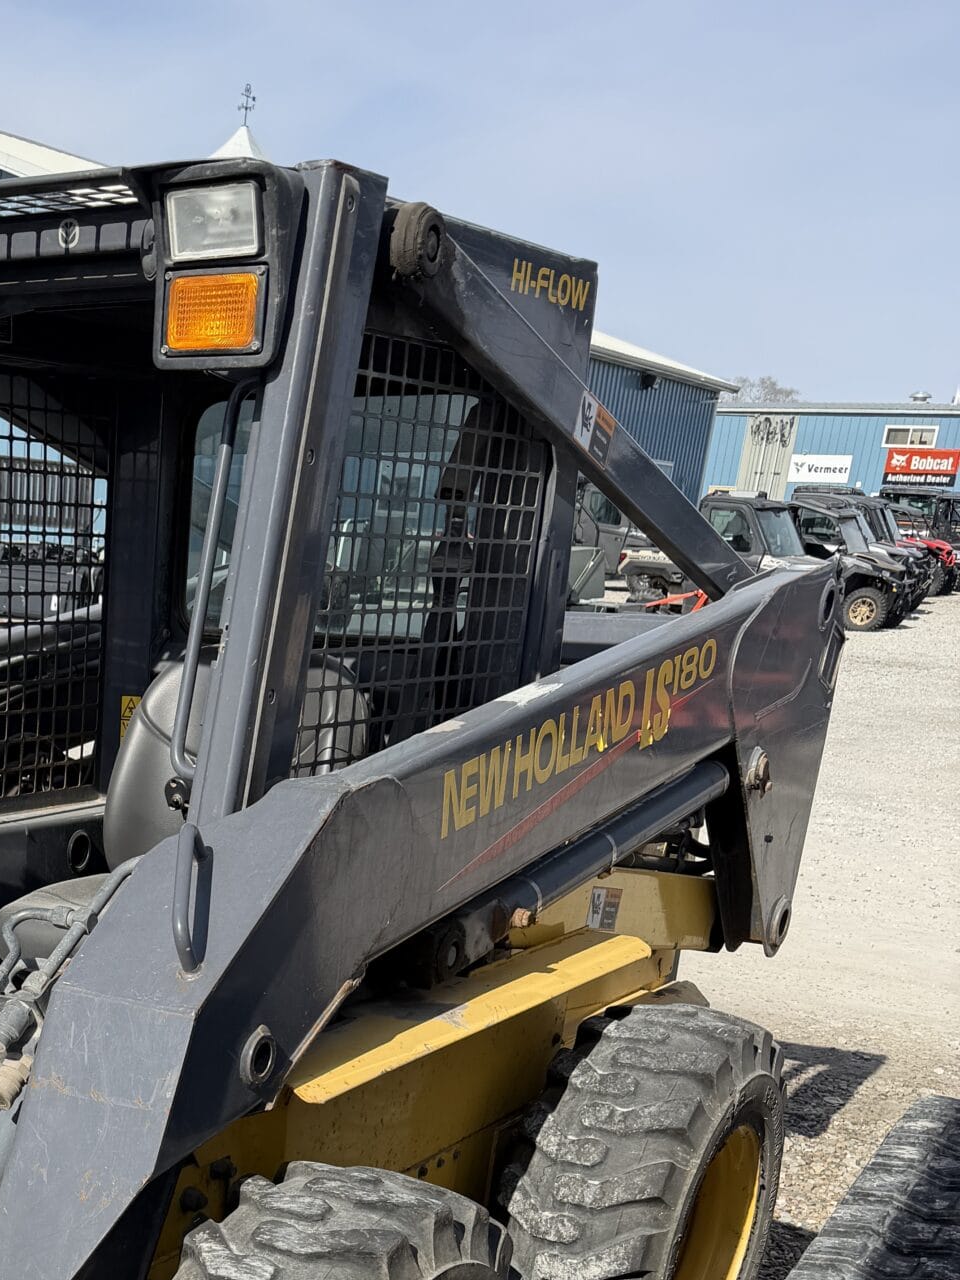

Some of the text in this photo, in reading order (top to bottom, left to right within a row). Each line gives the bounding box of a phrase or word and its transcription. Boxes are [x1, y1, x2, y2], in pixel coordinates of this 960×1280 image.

[510, 257, 590, 312] HI-FLOW
[807, 464, 849, 474] Vermeer
[910, 455, 953, 471] Bobcat
[886, 473, 951, 484] Authorized Dealer
[440, 740, 512, 840] NEW
[513, 680, 635, 799] HOLLAND
